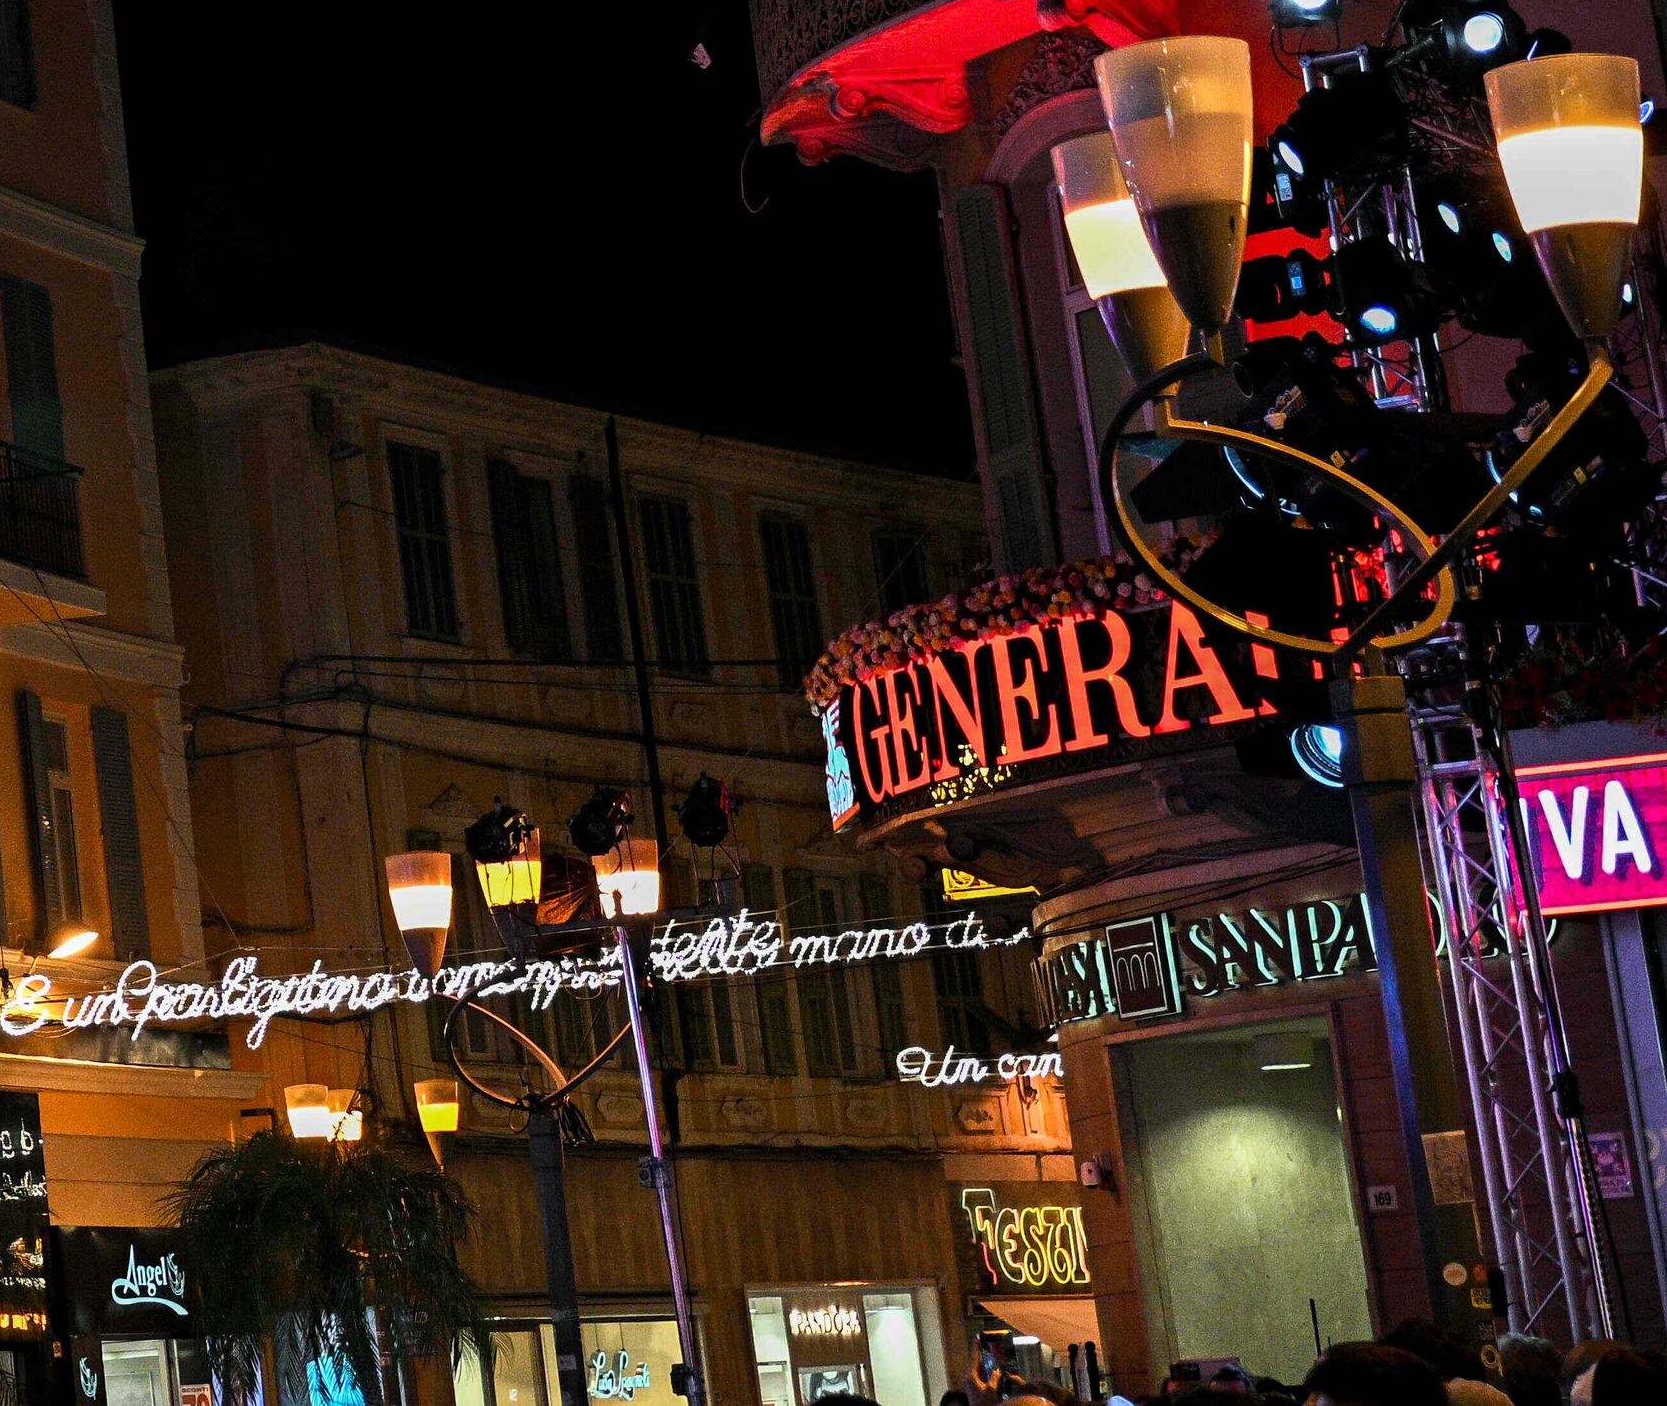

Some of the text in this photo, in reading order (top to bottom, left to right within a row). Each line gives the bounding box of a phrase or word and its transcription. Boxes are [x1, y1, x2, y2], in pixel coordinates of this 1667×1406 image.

[852, 598, 1362, 803] GENERA
[1519, 780, 1652, 880] VA
[962, 1188, 1090, 1286] FESTI
[790, 1304, 863, 1336] PANDORA
